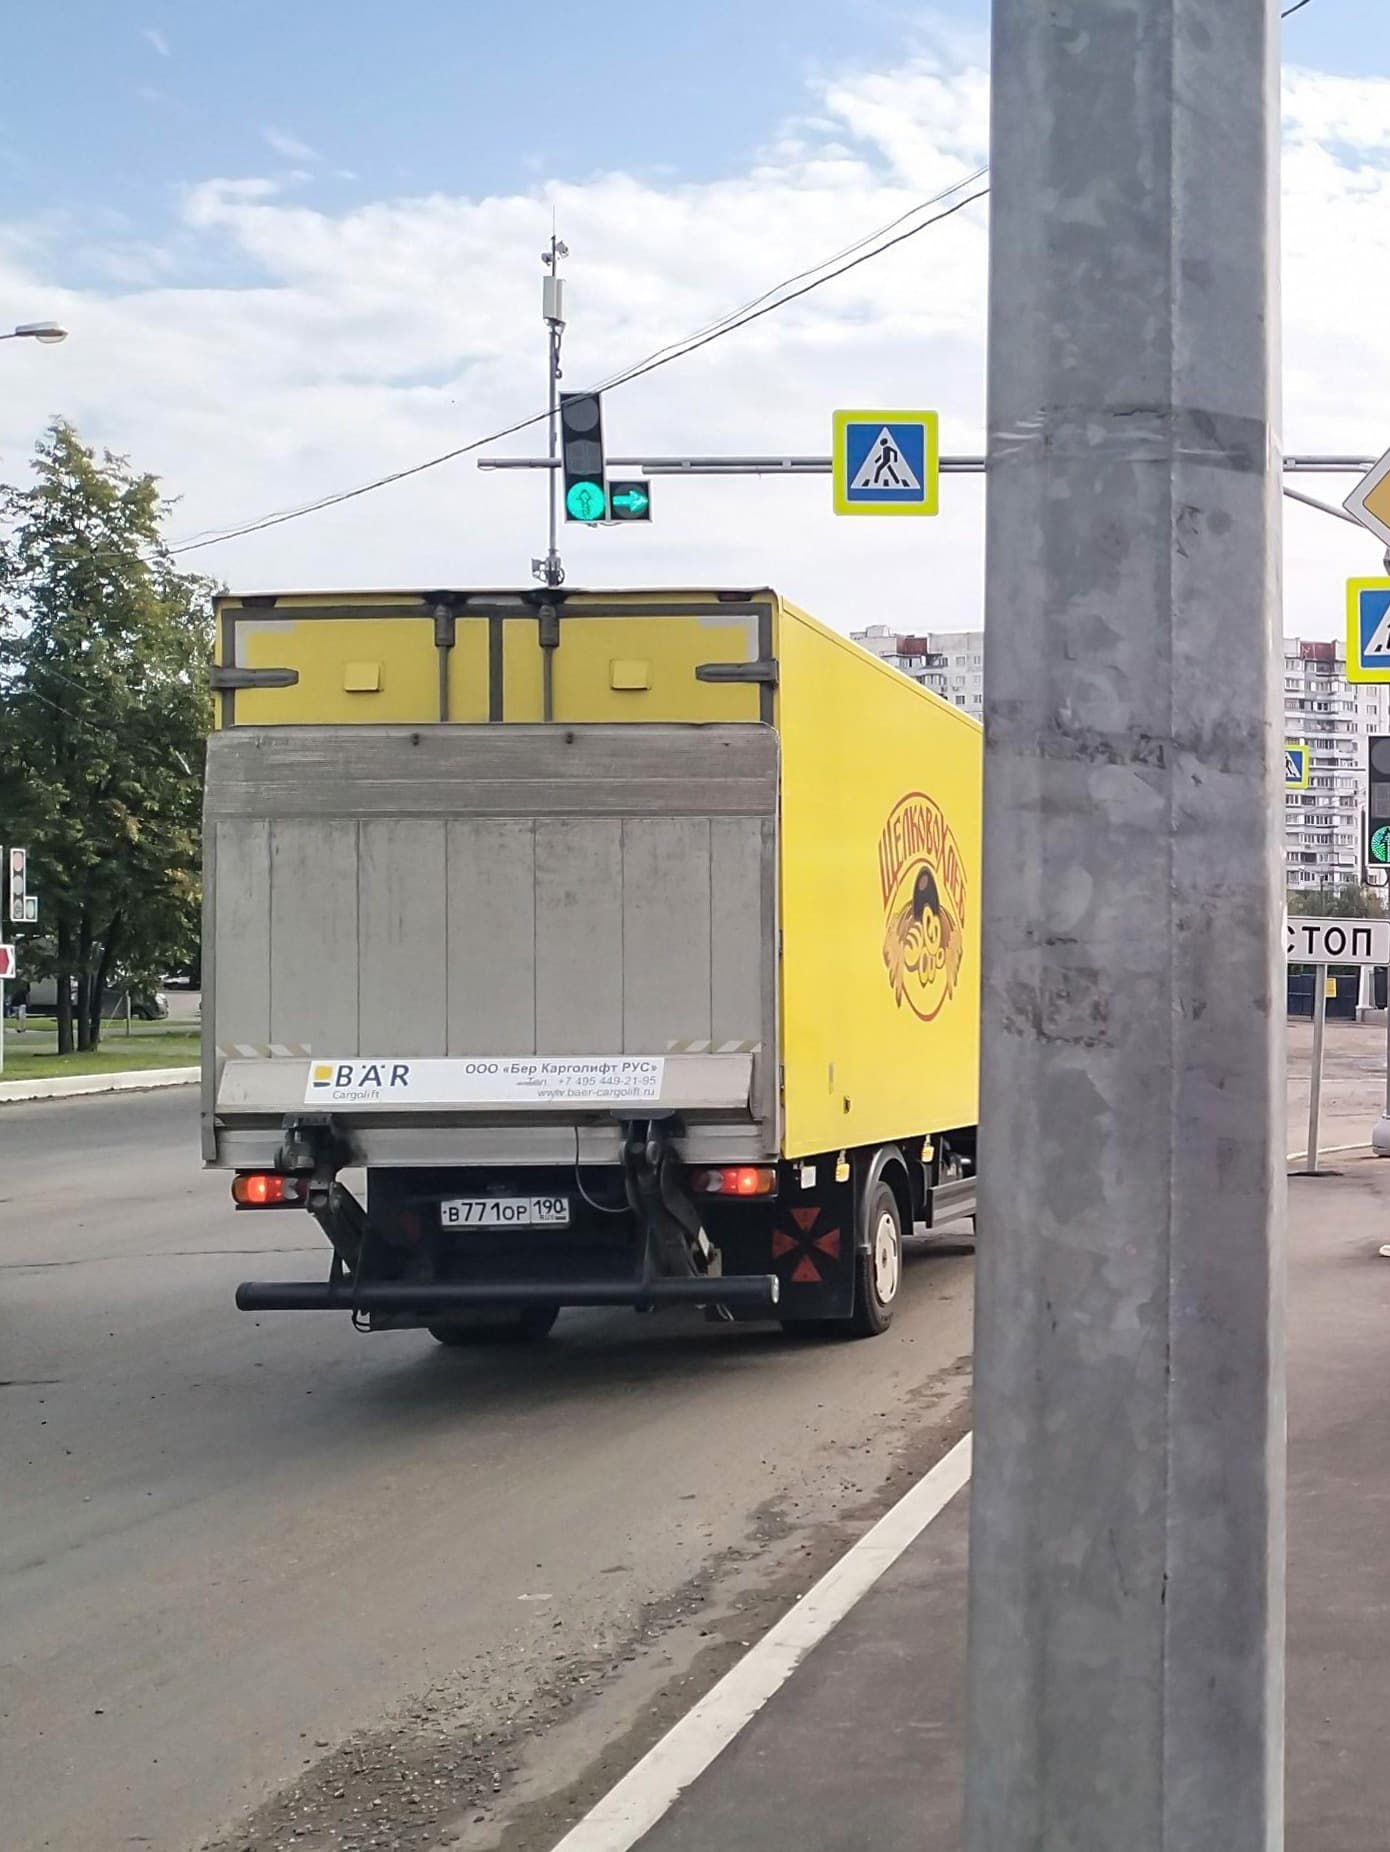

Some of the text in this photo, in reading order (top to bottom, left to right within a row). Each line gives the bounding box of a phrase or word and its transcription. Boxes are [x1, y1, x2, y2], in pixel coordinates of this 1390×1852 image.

[465, 1064, 498, 1074] ООО
[541, 1062, 618, 1075] Карголифт
[335, 1064, 410, 1087] BÄR
[332, 1089, 380, 1101] Cargolift
[533, 1200, 564, 1214] 190
